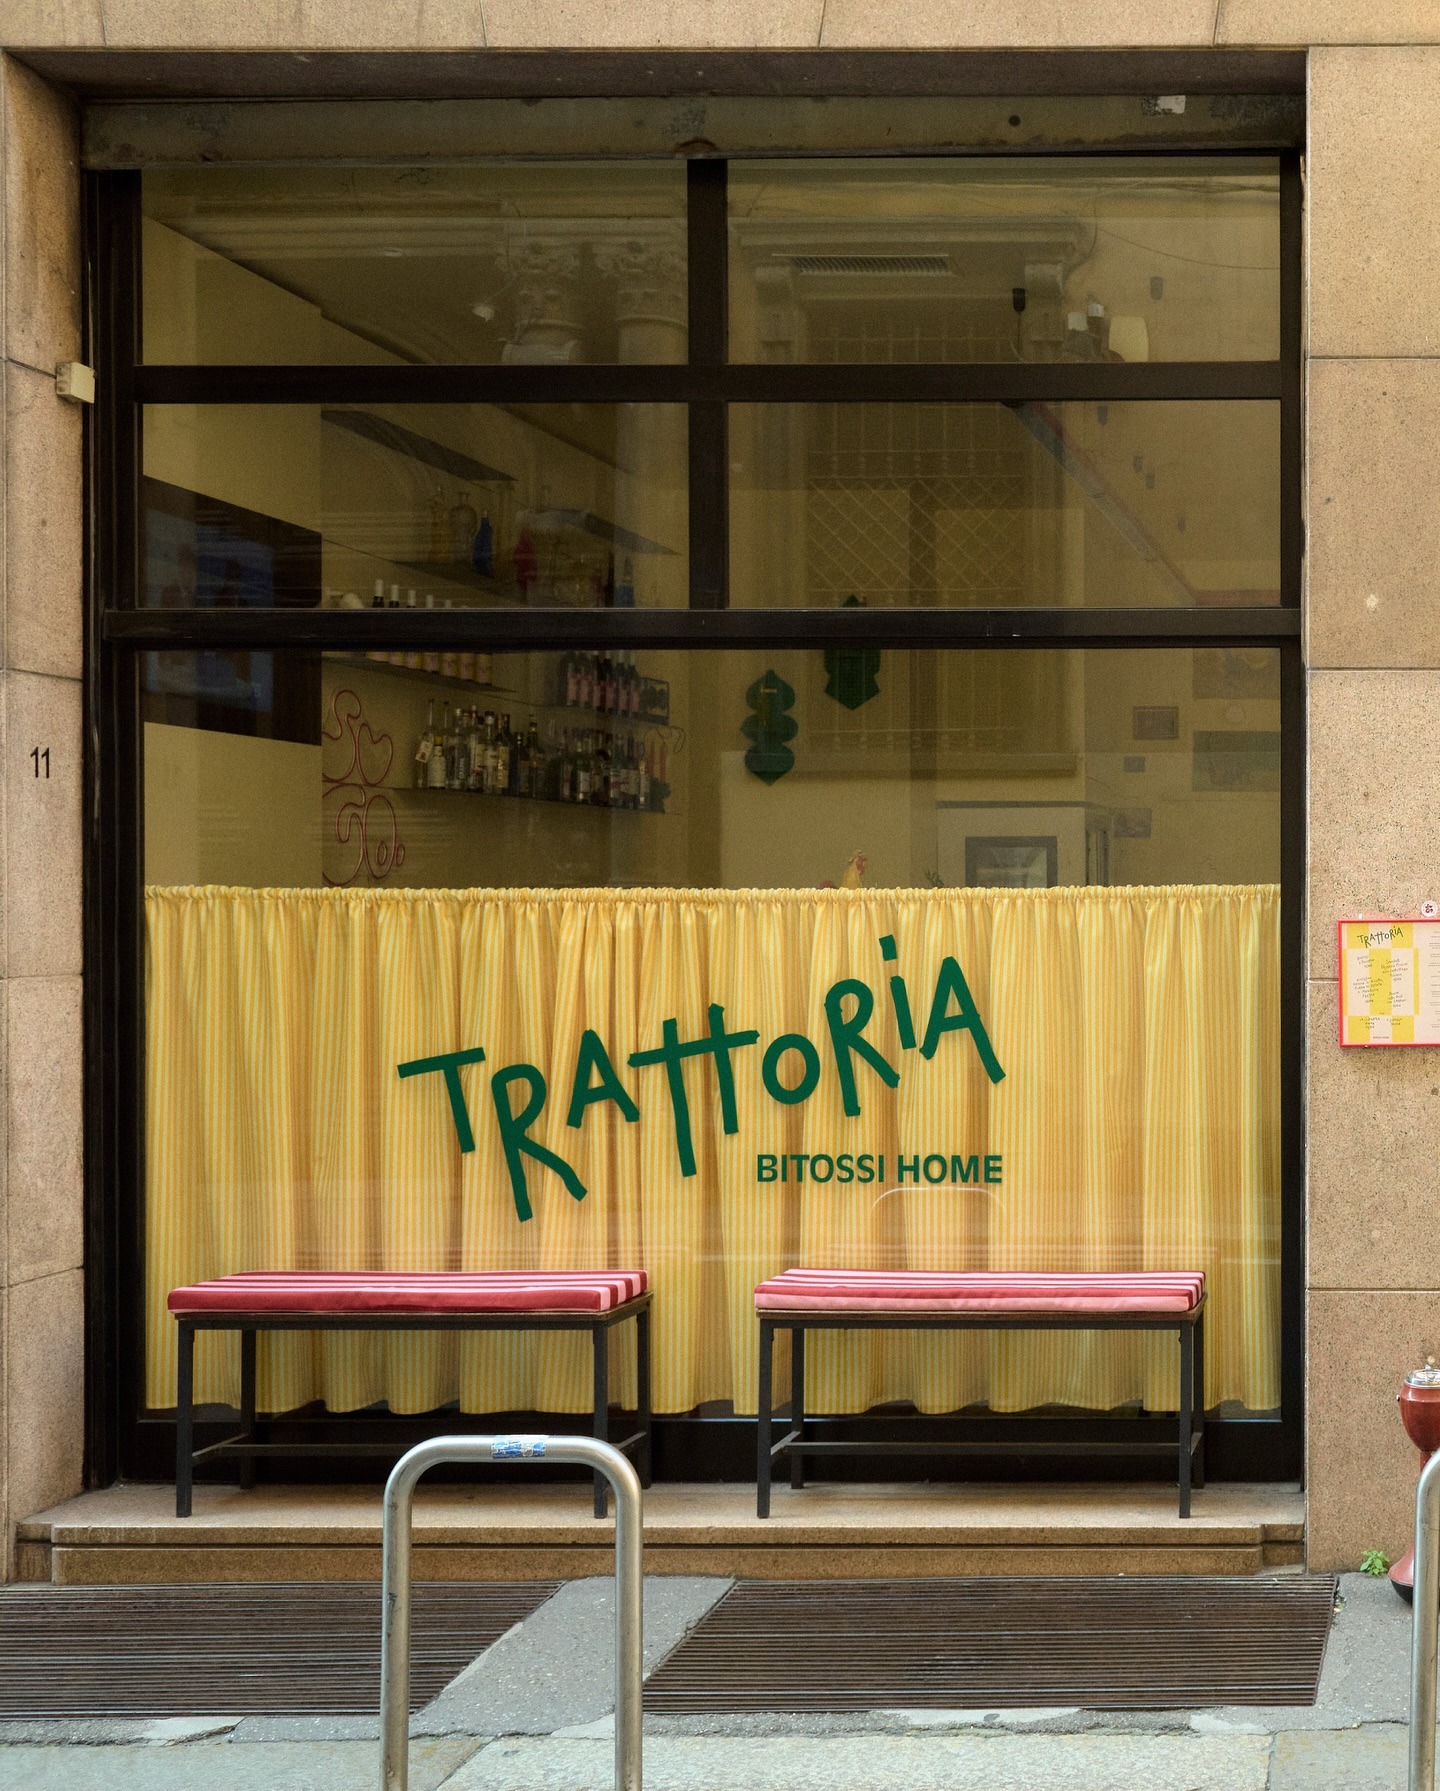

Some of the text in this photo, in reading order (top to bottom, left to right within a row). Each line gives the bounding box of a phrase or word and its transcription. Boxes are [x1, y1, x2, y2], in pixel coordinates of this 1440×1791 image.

[30, 746, 50, 779] 11
[757, 1154, 1003, 1184] BITOSSI HOME
